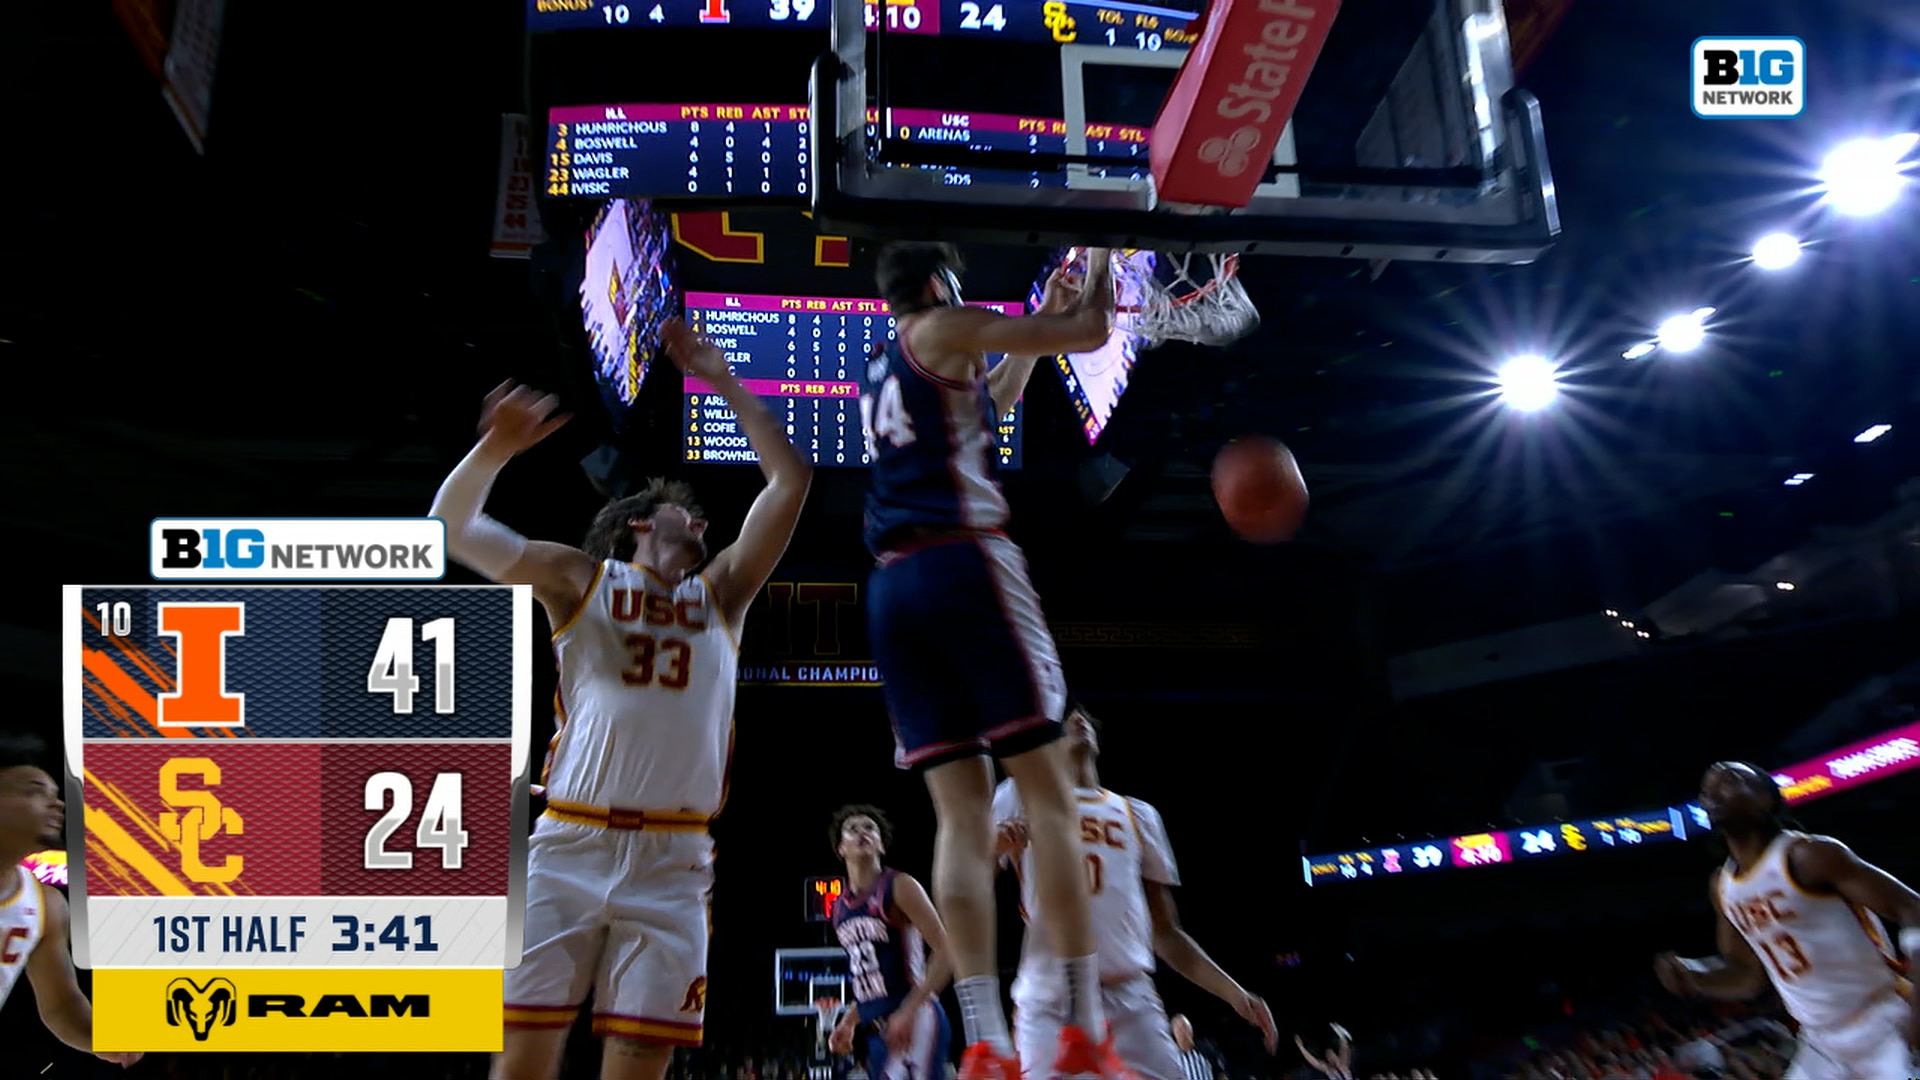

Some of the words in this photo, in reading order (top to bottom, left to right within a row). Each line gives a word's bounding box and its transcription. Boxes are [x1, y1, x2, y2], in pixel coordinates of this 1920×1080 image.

[603, 5, 630, 24] 10
[649, 4, 665, 23] 4
[769, 0, 815, 21] 39
[959, 1, 1006, 30] 24
[1105, 27, 1116, 46] 1
[1135, 31, 1162, 52] 10
[605, 107, 627, 119] ILL
[681, 106, 708, 119] PTS
[716, 106, 743, 119] REB
[752, 107, 781, 119] AST
[942, 114, 970, 127] USC
[557, 123, 568, 136] 3
[575, 121, 668, 135] HUMRICHOUS
[690, 121, 700, 133] 8
[725, 121, 735, 134] 4
[764, 121, 771, 134] 1
[798, 122, 807, 134] 0
[1019, 119, 1046, 133] PTS
[1085, 125, 1113, 138] AST
[1119, 128, 1145, 143] STL
[555, 138, 567, 151] 4
[574, 137, 638, 150] BOSWELL
[689, 136, 699, 148] 4
[725, 136, 735, 148] 0
[762, 136, 771, 149] 4
[799, 137, 807, 149] 2
[900, 126, 910, 140] 0
[918, 127, 971, 142] ARENAS
[1097, 141, 1104, 153] 1
[1130, 144, 1138, 156] 1
[551, 152, 570, 166] 15
[573, 152, 613, 165] DAVIS
[689, 151, 699, 163] 6
[725, 151, 734, 163] 5
[761, 151, 771, 164] 0
[797, 152, 807, 164] 0
[548, 168, 569, 182] 23
[572, 167, 629, 180] WAGLER
[688, 166, 698, 178] 4
[726, 166, 733, 178] 1
[763, 167, 770, 179] 1
[799, 167, 806, 180] 1
[547, 183, 569, 196] 44
[571, 182, 610, 194] IVISIC
[688, 180, 698, 193] 0
[726, 180, 733, 193] 1
[761, 181, 771, 194] 0
[797, 181, 807, 194] 0
[725, 297, 741, 307] ILL
[781, 299, 801, 309] PTS
[806, 300, 826, 310] REB
[832, 301, 853, 311] AST
[857, 302, 877, 312] STL
[692, 310, 700, 320] 3
[705, 310, 780, 324] HUMRICHOUS
[788, 314, 796, 325] 8
[812, 314, 821, 326] 4
[839, 315, 846, 327] 1
[863, 316, 872, 327] 0
[887, 317, 896, 328] 0
[692, 323, 699, 333] 4
[705, 323, 757, 336] BOSWELL
[787, 326, 796, 337] 4
[812, 327, 821, 338] 0
[838, 328, 847, 339] 4
[863, 329, 871, 340] 2
[887, 329, 896, 340] 0
[787, 340, 796, 352] 6
[812, 341, 820, 352] 5
[838, 342, 846, 353] 0
[863, 342, 871, 353] 0
[724, 352, 751, 363] GLER
[787, 354, 796, 365] 4
[814, 355, 820, 366] 1
[839, 356, 845, 367] 1
[787, 367, 796, 378] 0
[814, 368, 820, 379] 1
[837, 368, 846, 380] 0
[781, 383, 800, 393] PTS
[805, 384, 825, 394] REB
[830, 385, 851, 395] AST
[690, 395, 699, 406] 0
[704, 395, 728, 406] ARE
[787, 398, 794, 409] 3
[813, 399, 819, 410] 1
[839, 399, 844, 410] 1
[690, 409, 698, 419] 5
[787, 411, 794, 422] 3
[813, 412, 818, 422] 1
[837, 412, 845, 423] 0
[690, 422, 698, 432] 6
[703, 422, 736, 433] COFIE
[787, 424, 794, 435] 8
[813, 425, 818, 436] 1
[838, 426, 844, 436] 1
[687, 436, 701, 446] 13
[703, 436, 748, 448] WOODS
[811, 439, 818, 449] 2
[837, 439, 844, 450] 3
[687, 450, 700, 460] 33
[813, 453, 818, 463] 1
[837, 453, 845, 463] 0
[862, 454, 869, 464] 0
[611, 588, 707, 632] USC
[621, 633, 692, 692] 33
[798, 666, 883, 681] CHAMPIO
[1080, 815, 1126, 850] SC
[1758, 931, 1812, 982] 13
